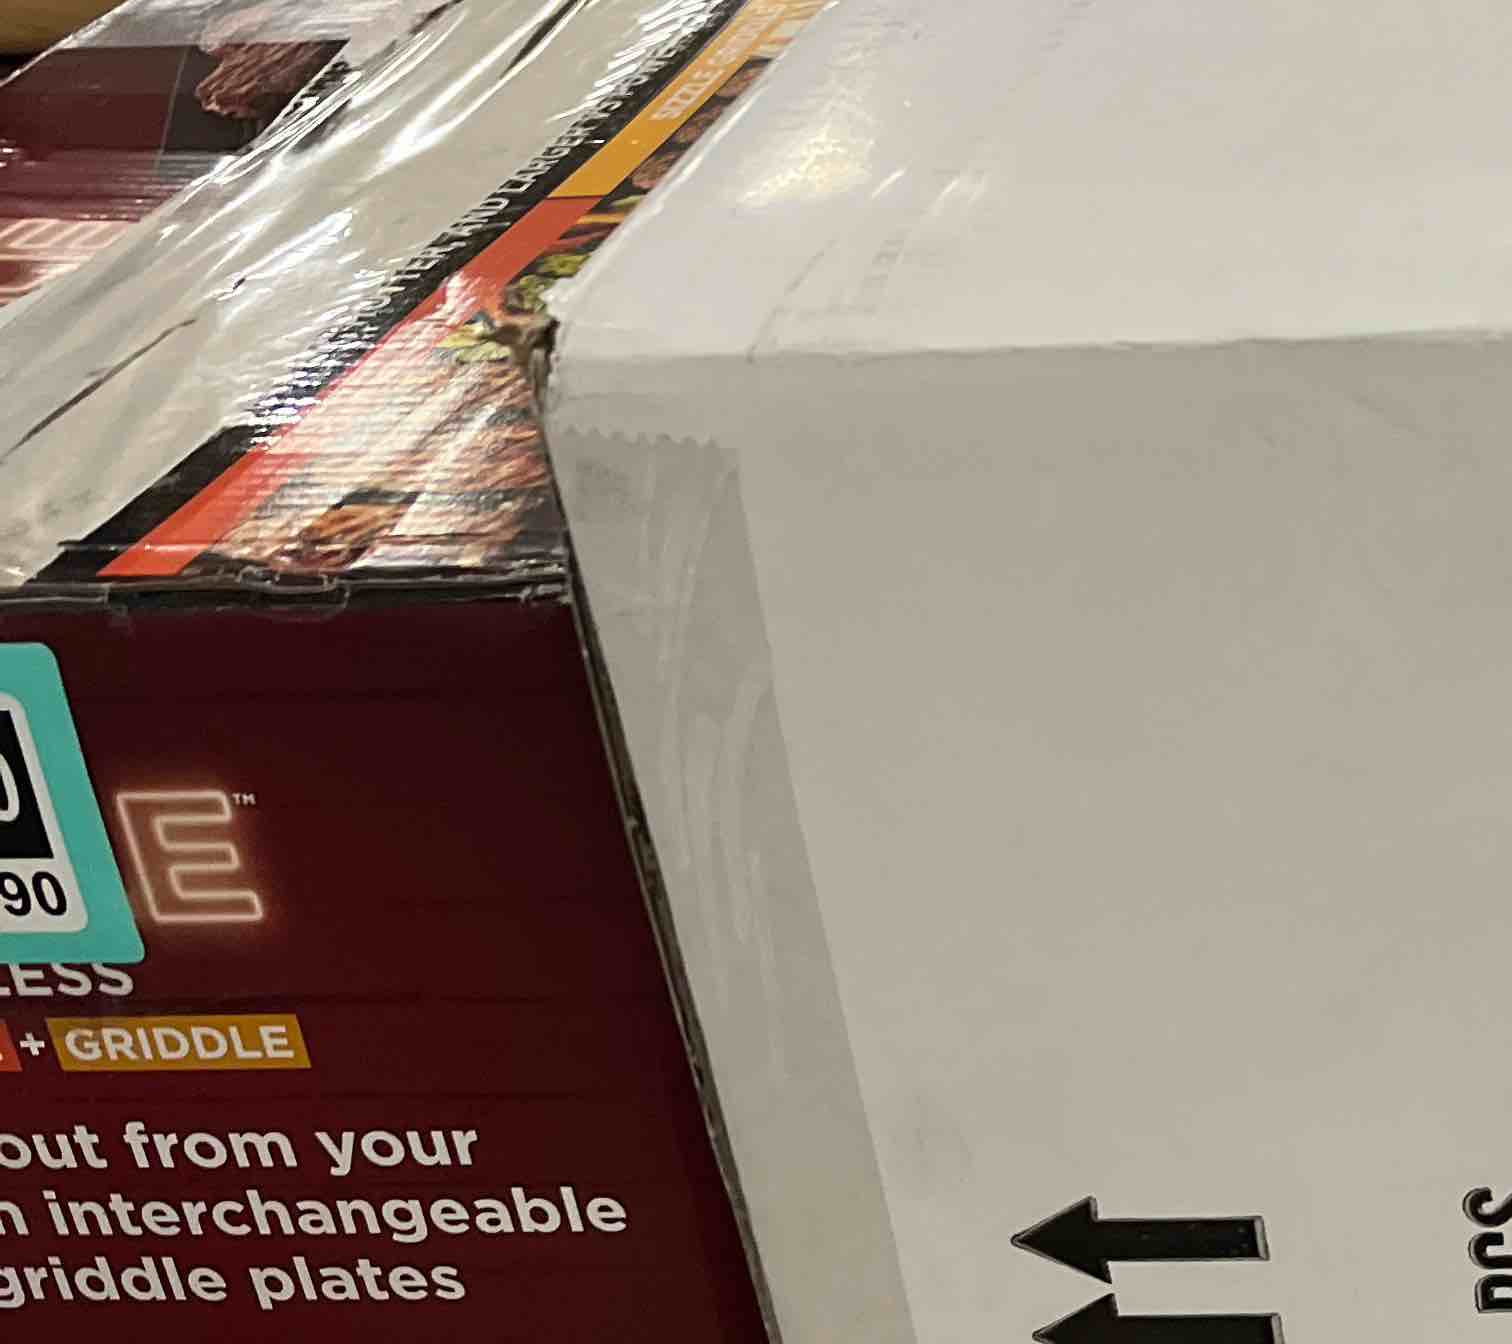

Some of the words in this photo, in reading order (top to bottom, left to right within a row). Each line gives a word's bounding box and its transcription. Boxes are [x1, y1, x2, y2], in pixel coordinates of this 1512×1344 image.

[0, 963, 134, 997] ESS
[64, 1024, 295, 1062] GRIDDLE
[0, 1125, 108, 1169] out
[123, 1121, 298, 1170] from
[315, 1126, 479, 1177] your
[42, 1187, 628, 1244] interchangeable
[0, 1256, 227, 1309] griddle
[249, 1256, 467, 1310] plates
